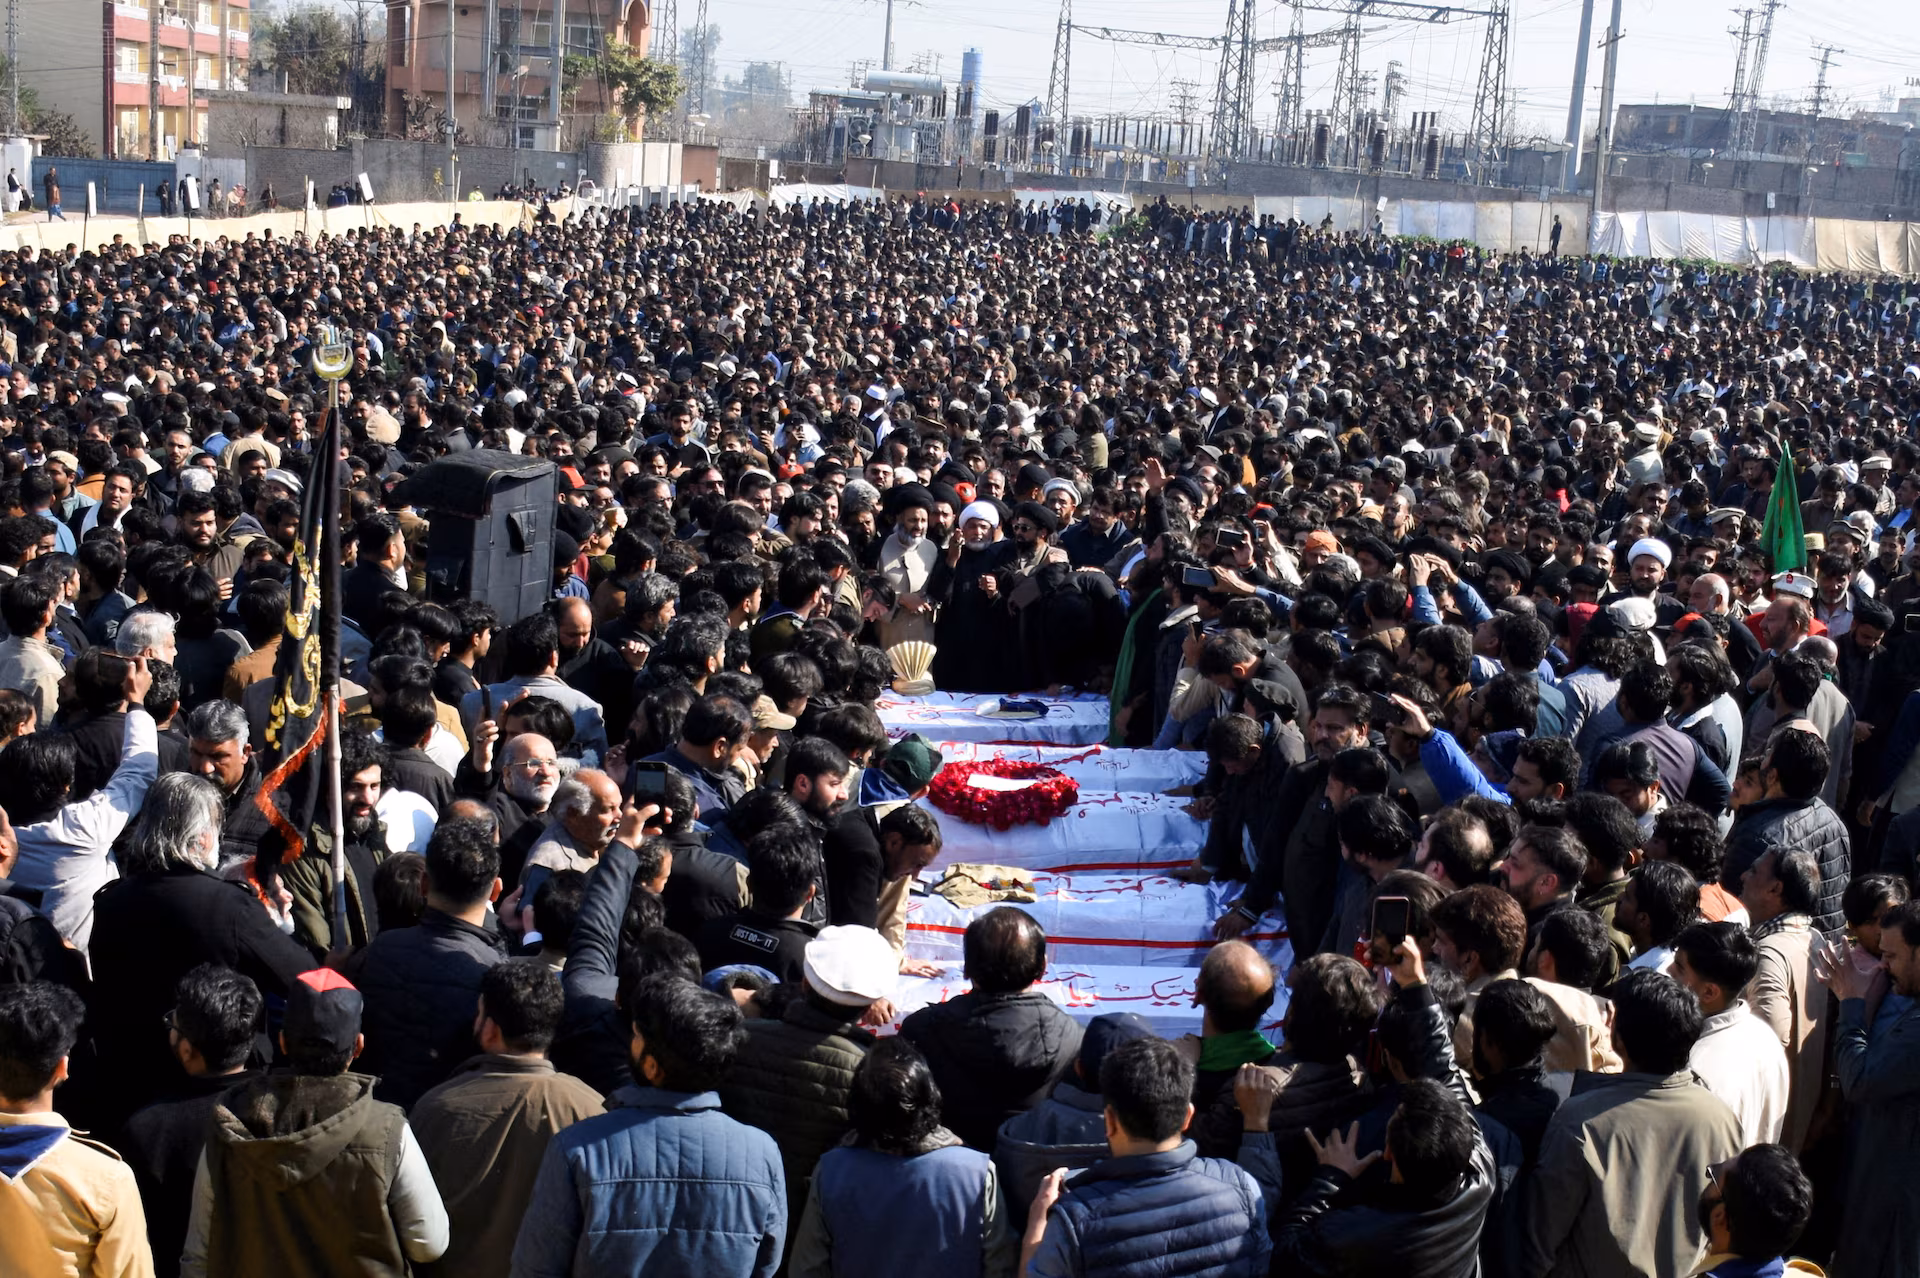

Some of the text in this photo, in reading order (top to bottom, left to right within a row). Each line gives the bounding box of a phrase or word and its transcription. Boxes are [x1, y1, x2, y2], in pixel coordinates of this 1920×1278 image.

[735, 928, 772, 947] JUST DO IT
